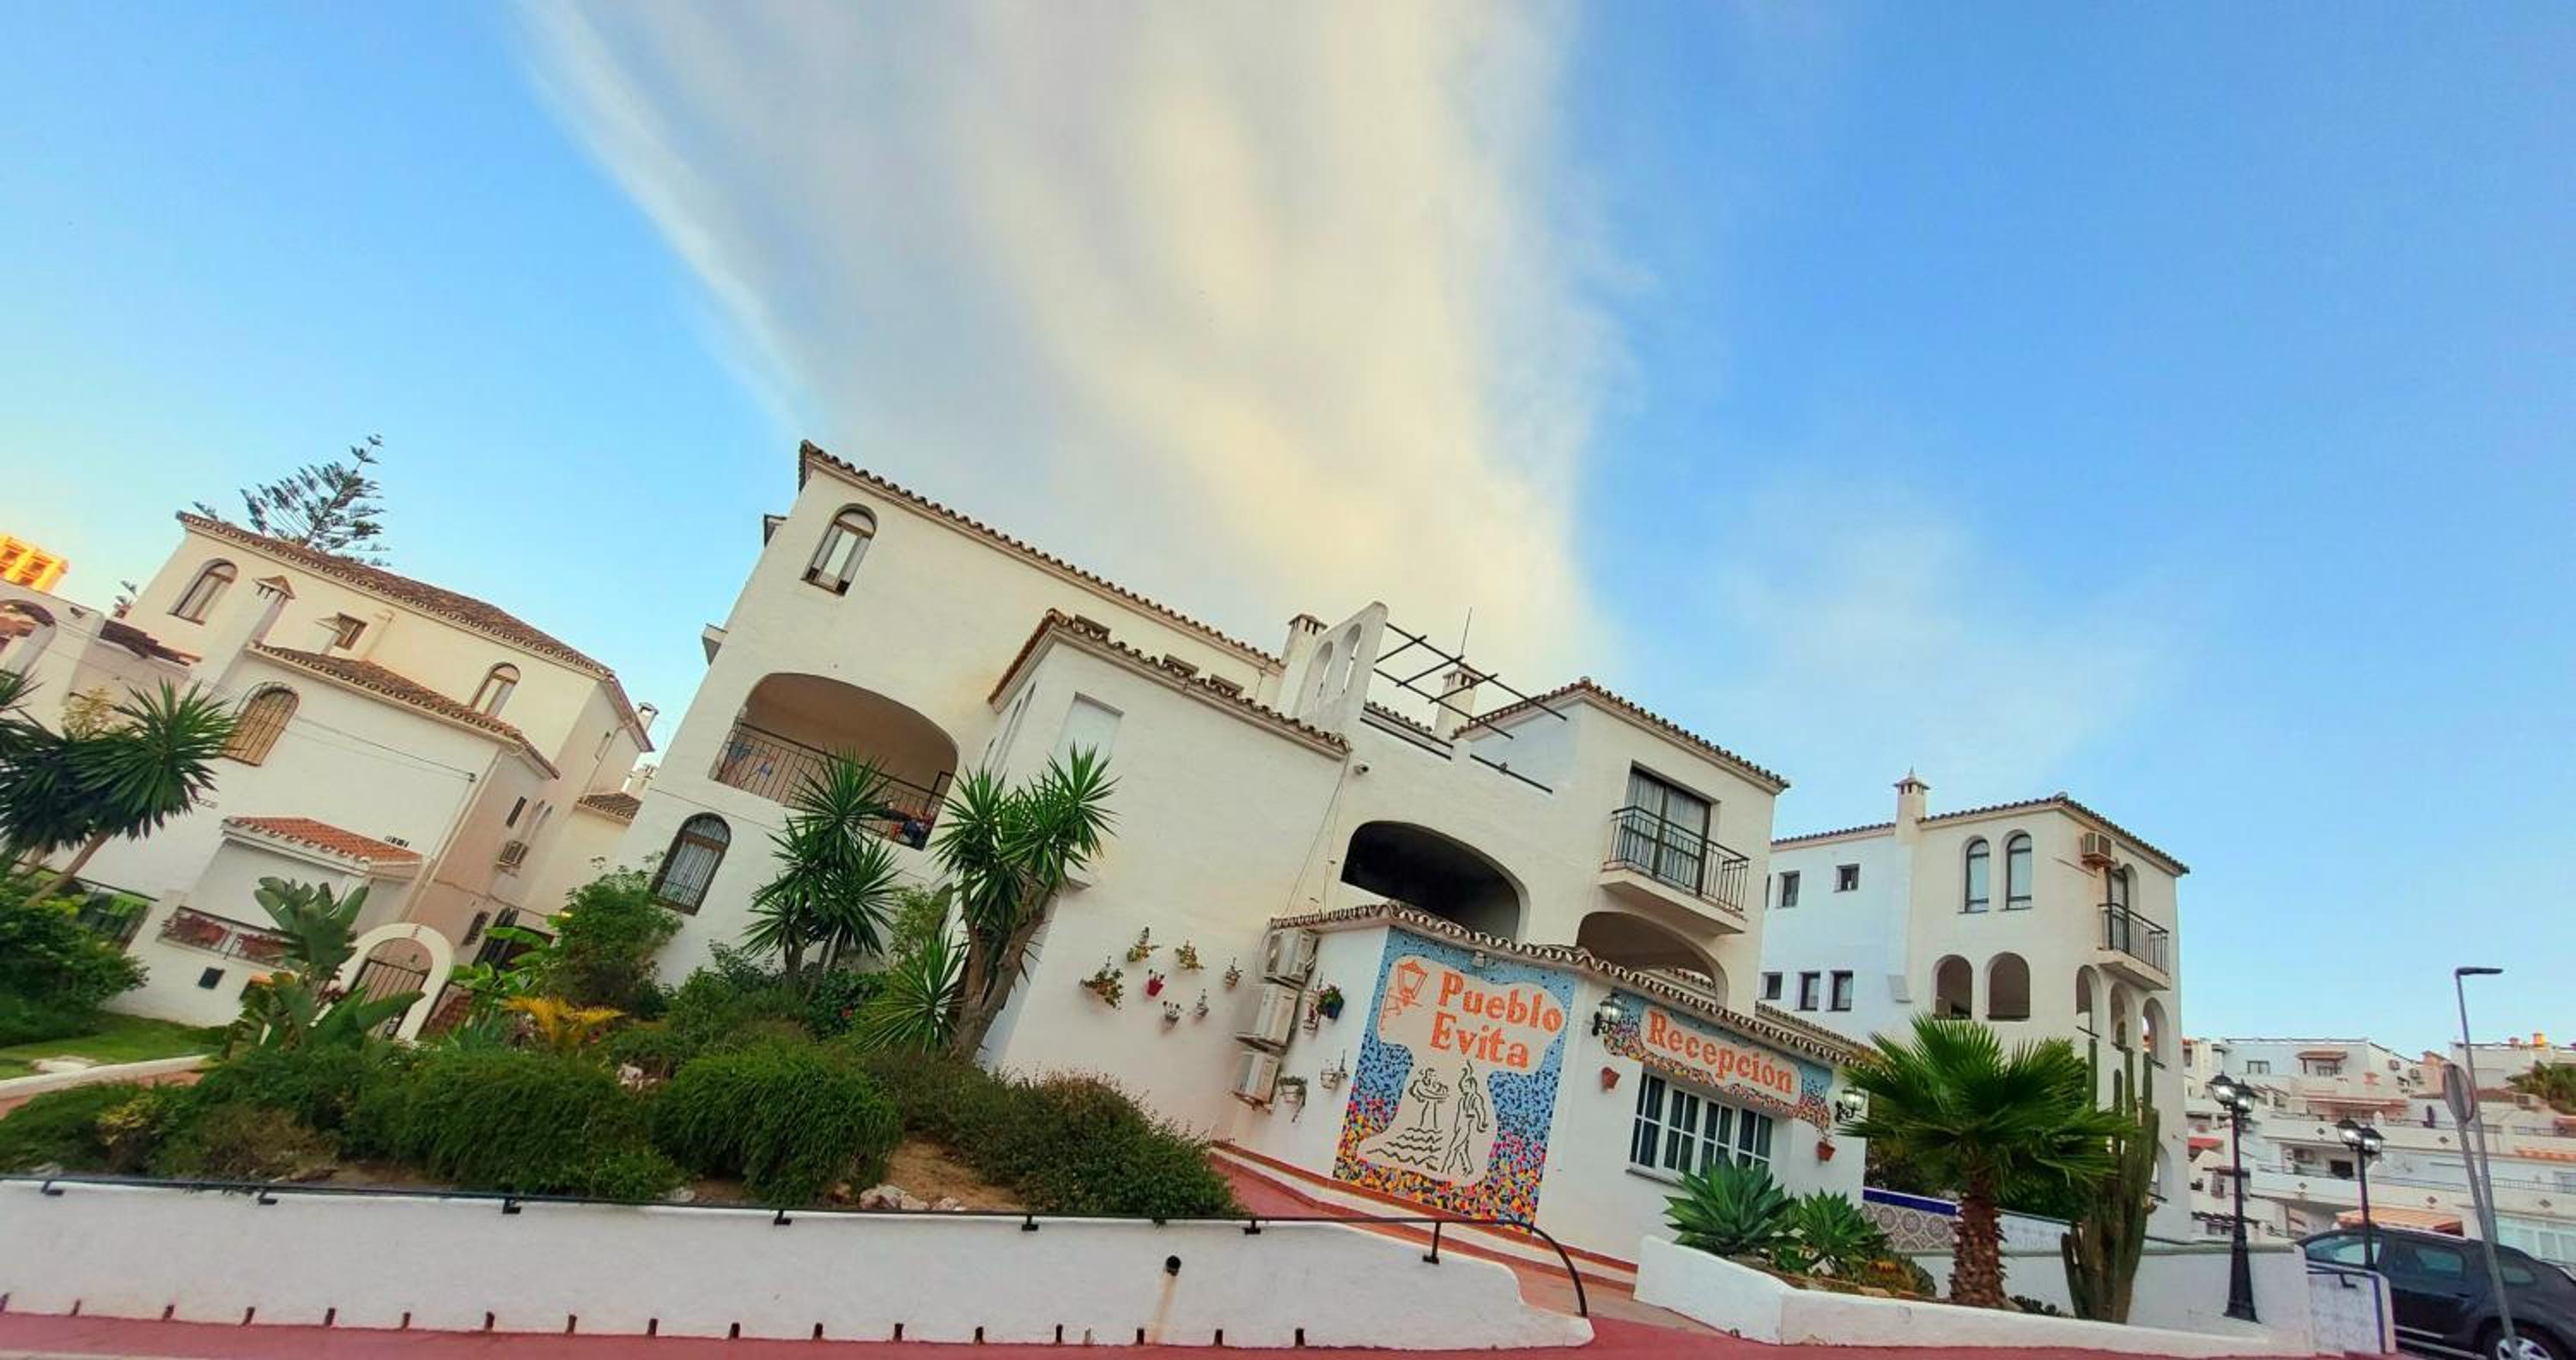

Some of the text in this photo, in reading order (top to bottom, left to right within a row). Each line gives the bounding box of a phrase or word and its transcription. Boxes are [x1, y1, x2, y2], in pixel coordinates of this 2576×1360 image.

[1439, 972, 1562, 1032] Pueblo
[1431, 1011, 1528, 1069] Evita
[1648, 1011, 1793, 1094] Recepción
